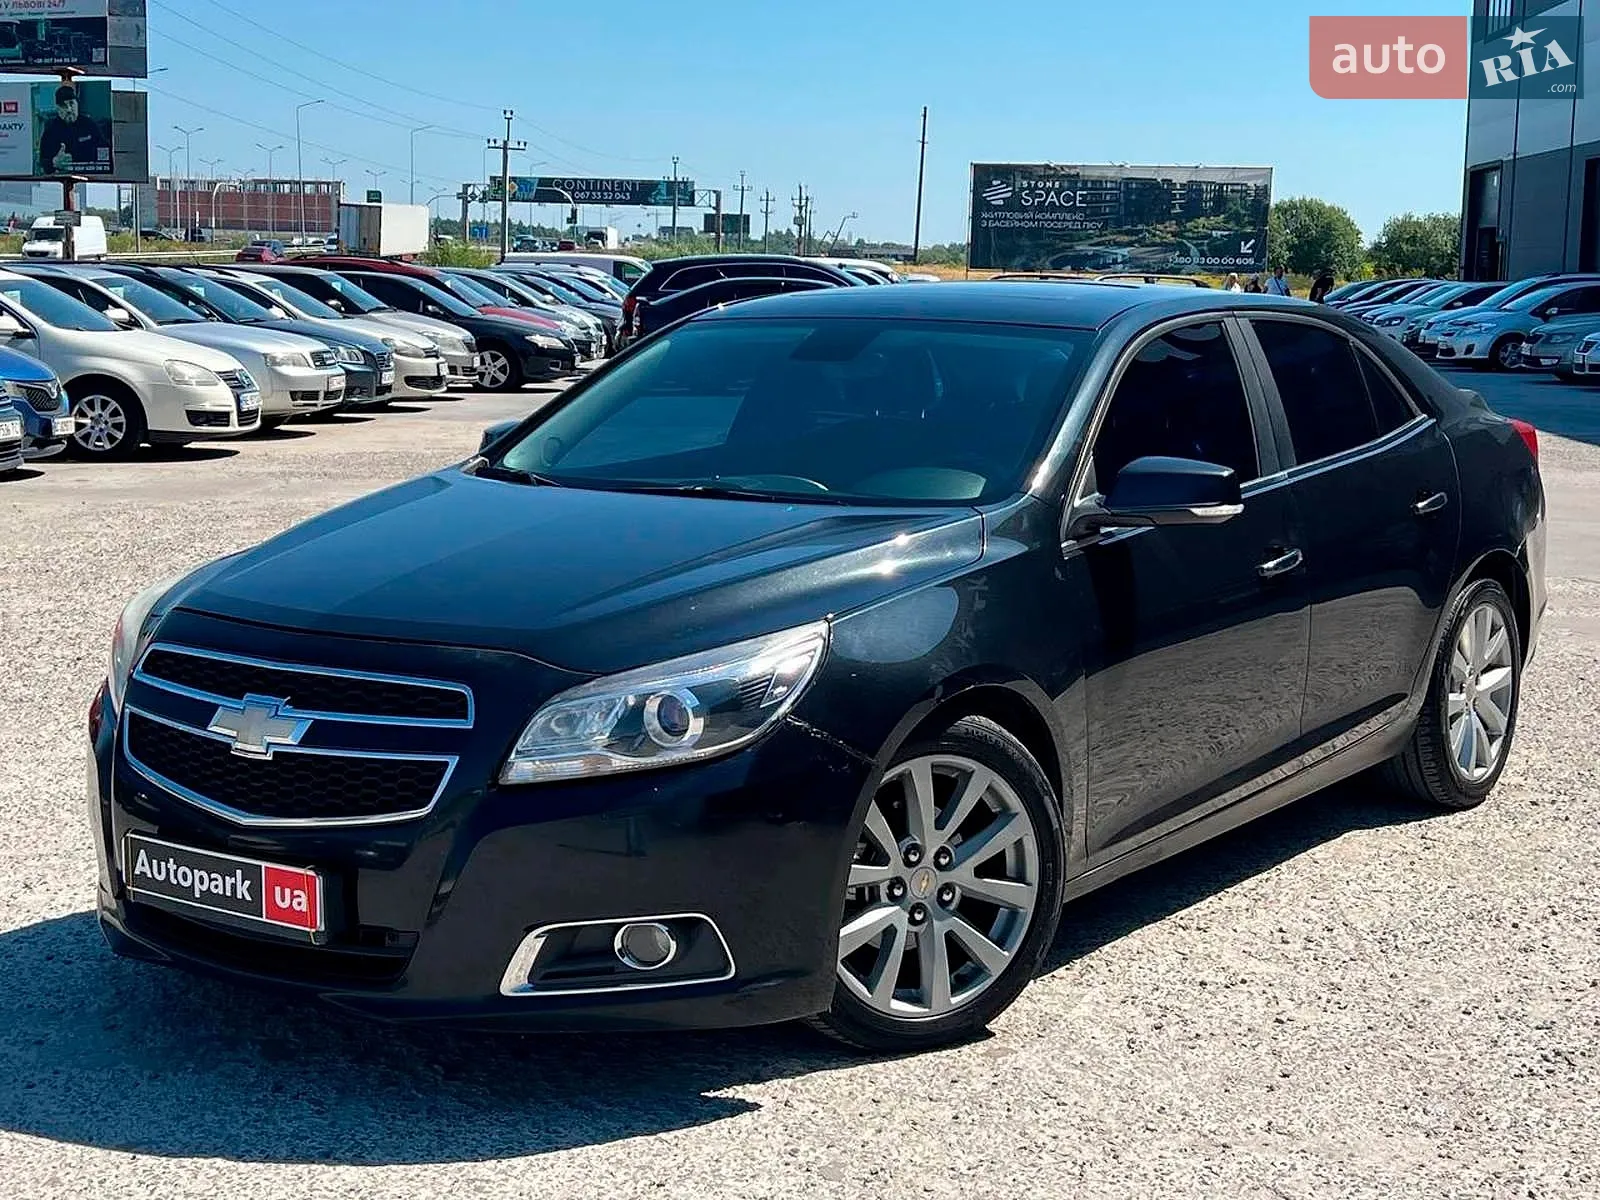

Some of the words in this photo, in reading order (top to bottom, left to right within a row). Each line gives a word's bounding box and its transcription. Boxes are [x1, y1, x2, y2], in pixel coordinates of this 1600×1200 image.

[0, 122, 24, 131] АКТУ
[552, 179, 641, 192] CONTINENT
[1022, 180, 1061, 188] STONE
[1020, 190, 1088, 207] SPACE
[134, 849, 252, 901] Autopark
[274, 885, 308, 912] ua
